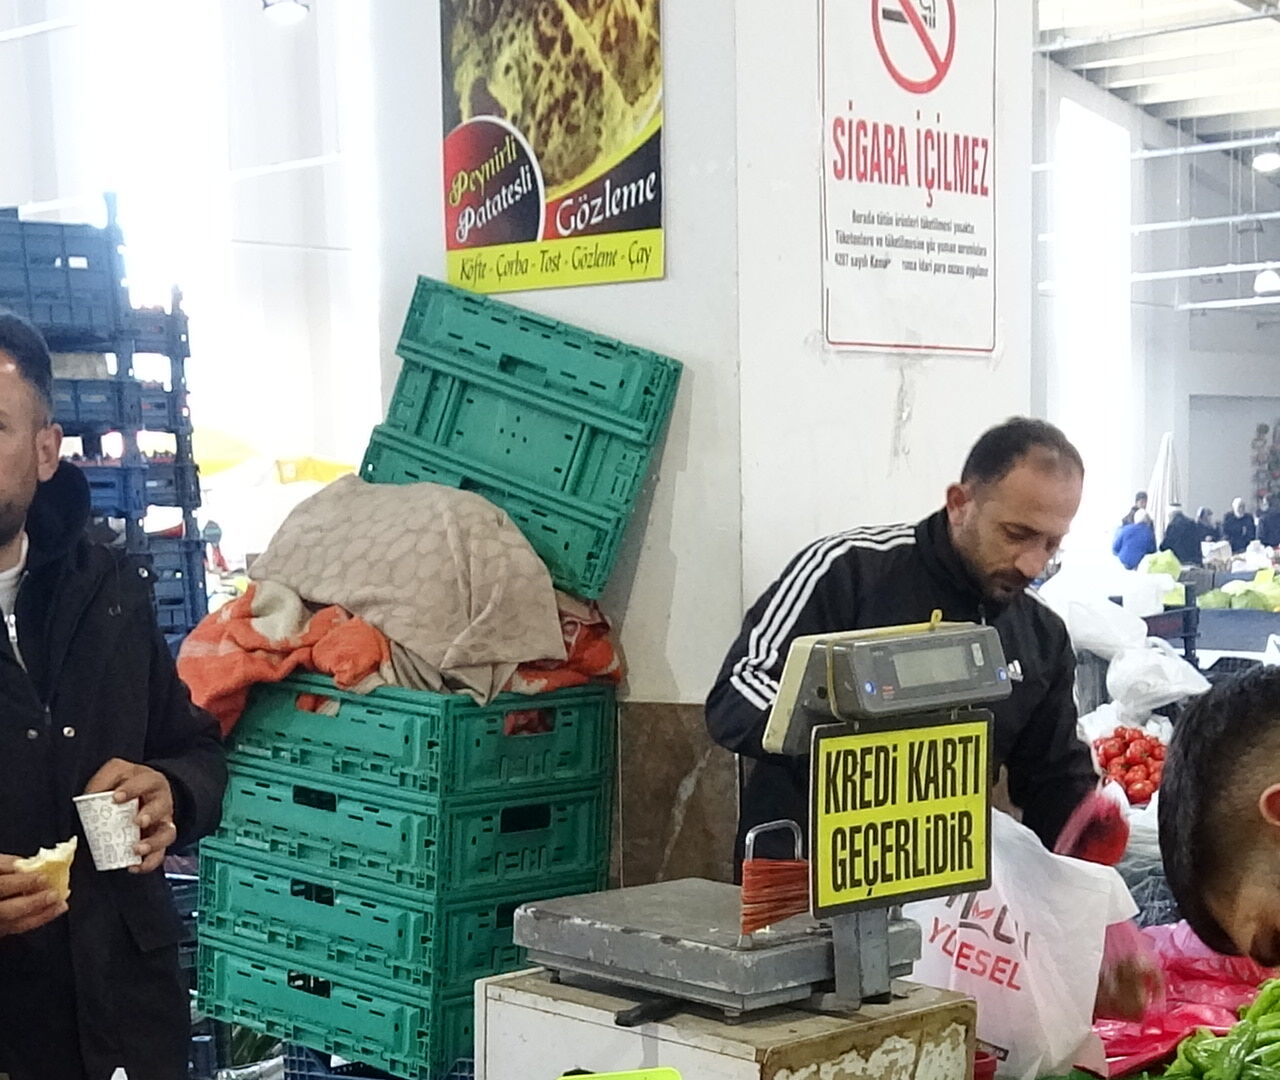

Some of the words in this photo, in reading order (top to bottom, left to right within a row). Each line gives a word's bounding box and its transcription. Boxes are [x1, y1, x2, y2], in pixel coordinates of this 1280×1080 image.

[449, 135, 517, 207] Peynirli
[833, 100, 909, 187] SİGARA
[917, 109, 989, 208] İÇİLMEZ
[456, 165, 532, 243] Patatesli
[556, 171, 657, 236] Gözleme
[459, 256, 487, 286] Köfte
[496, 250, 528, 283] Çorba
[572, 243, 618, 270] Gözleme
[628, 240, 652, 274] Çay
[824, 743, 899, 815] KREDİ
[908, 734, 981, 804] KARTI
[831, 810, 973, 897] GEÇERLİDİR
